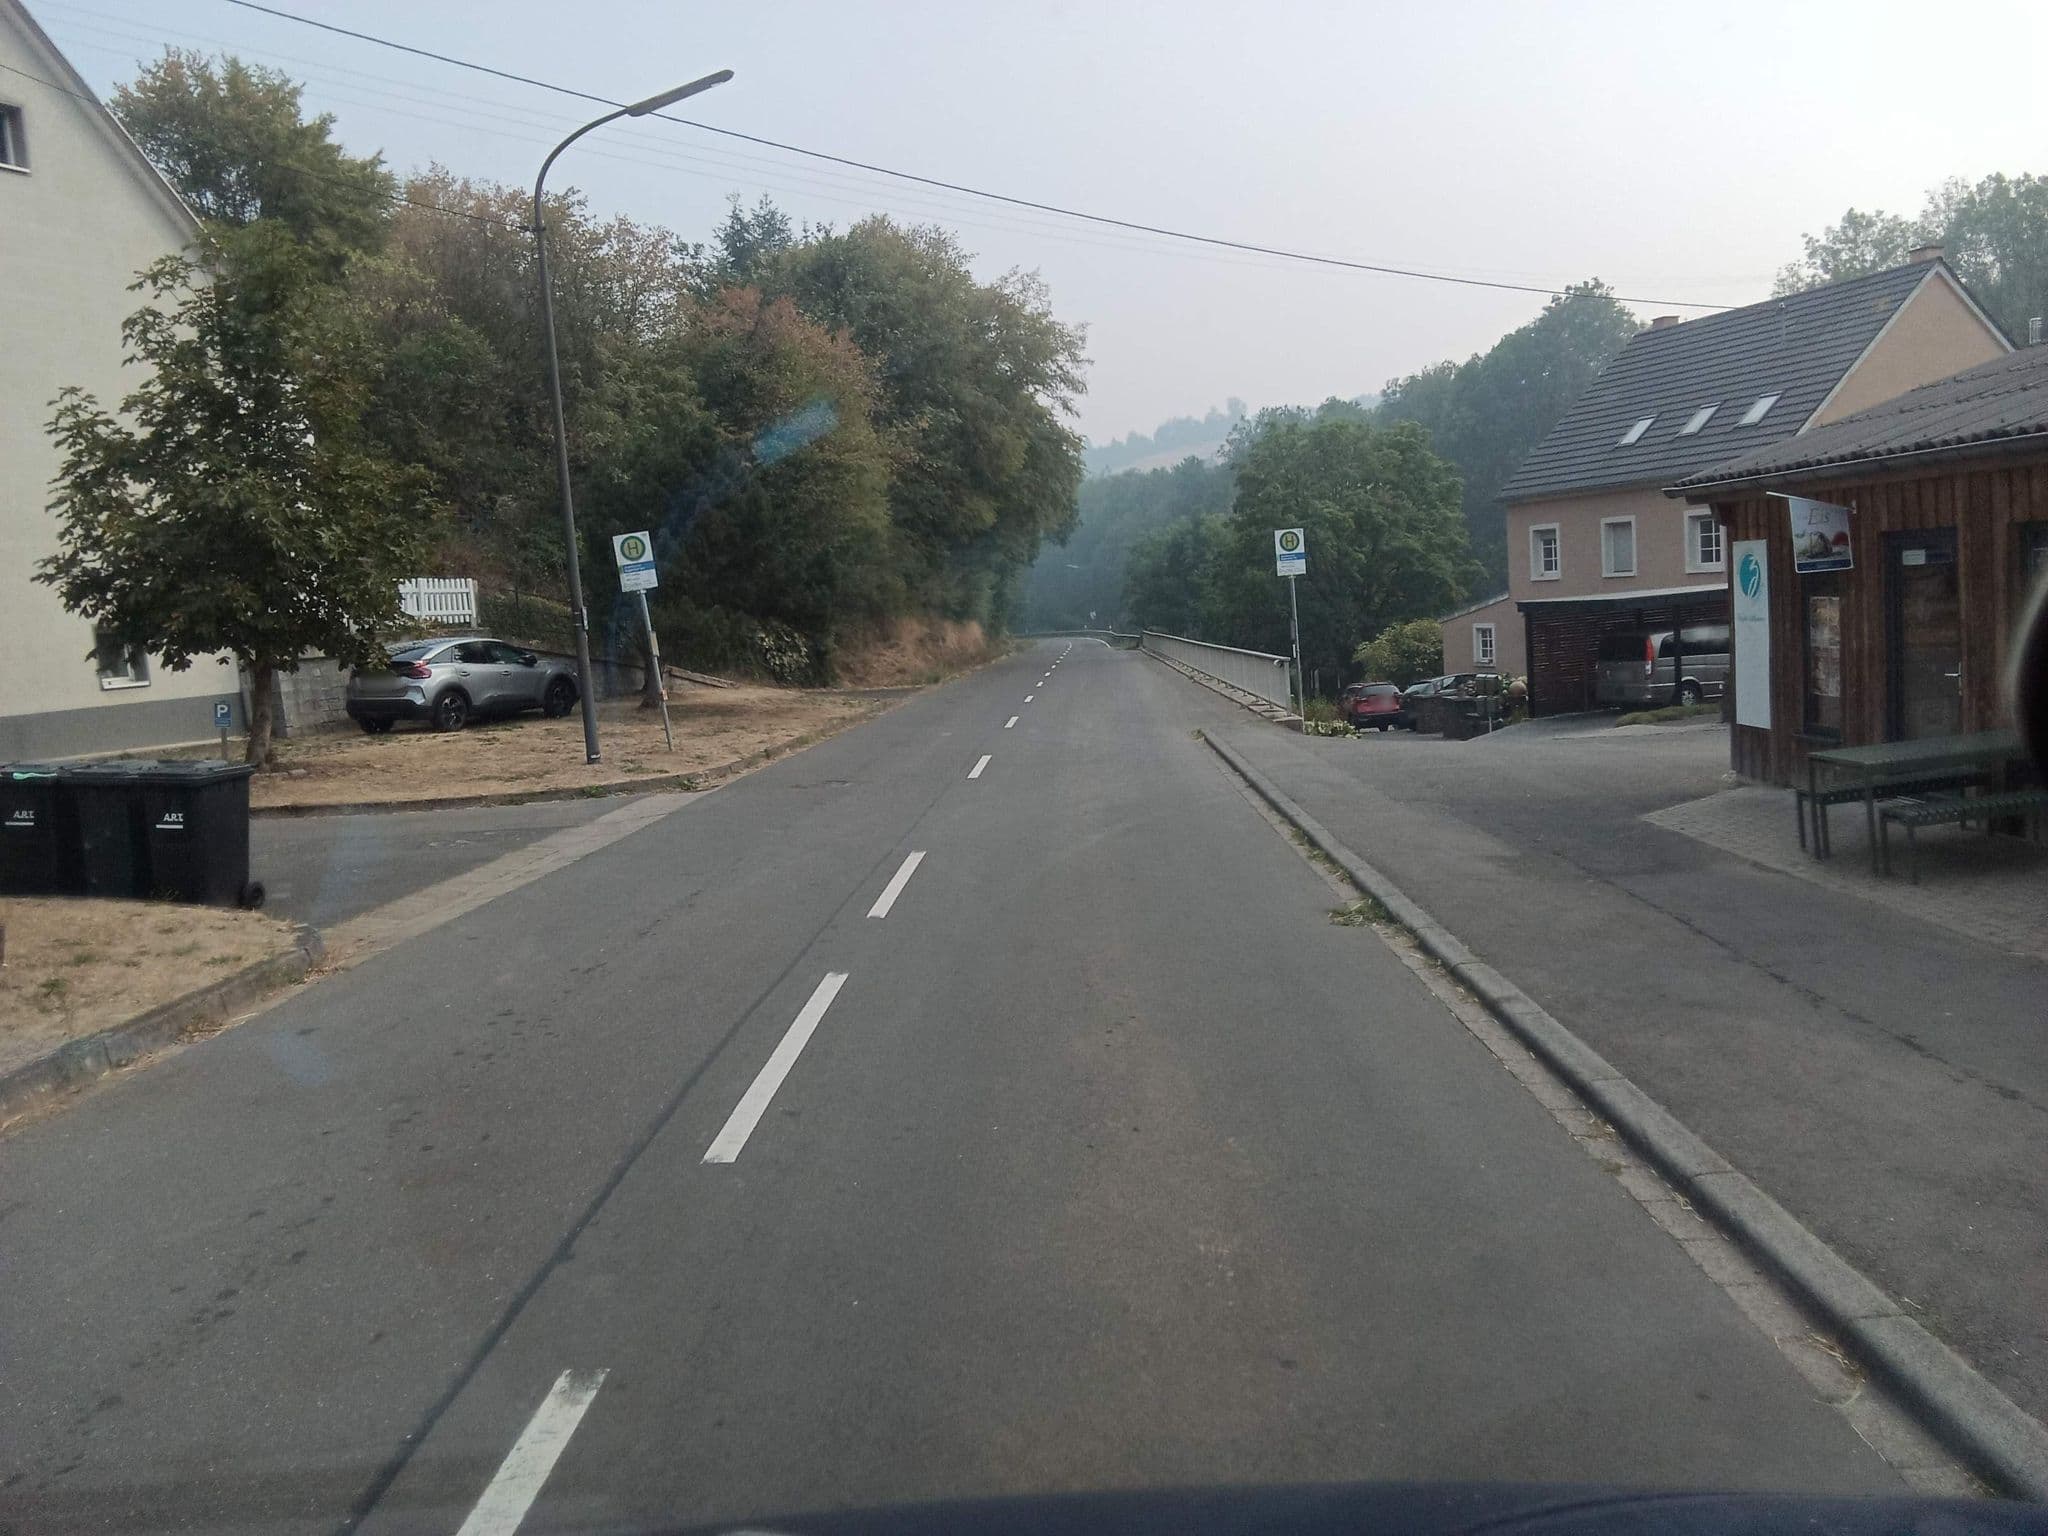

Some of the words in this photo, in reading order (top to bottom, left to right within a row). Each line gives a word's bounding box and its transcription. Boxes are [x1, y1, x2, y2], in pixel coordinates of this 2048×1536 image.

[1285, 535, 1294, 547] H
[627, 541, 639, 555] H
[217, 704, 228, 717] P
